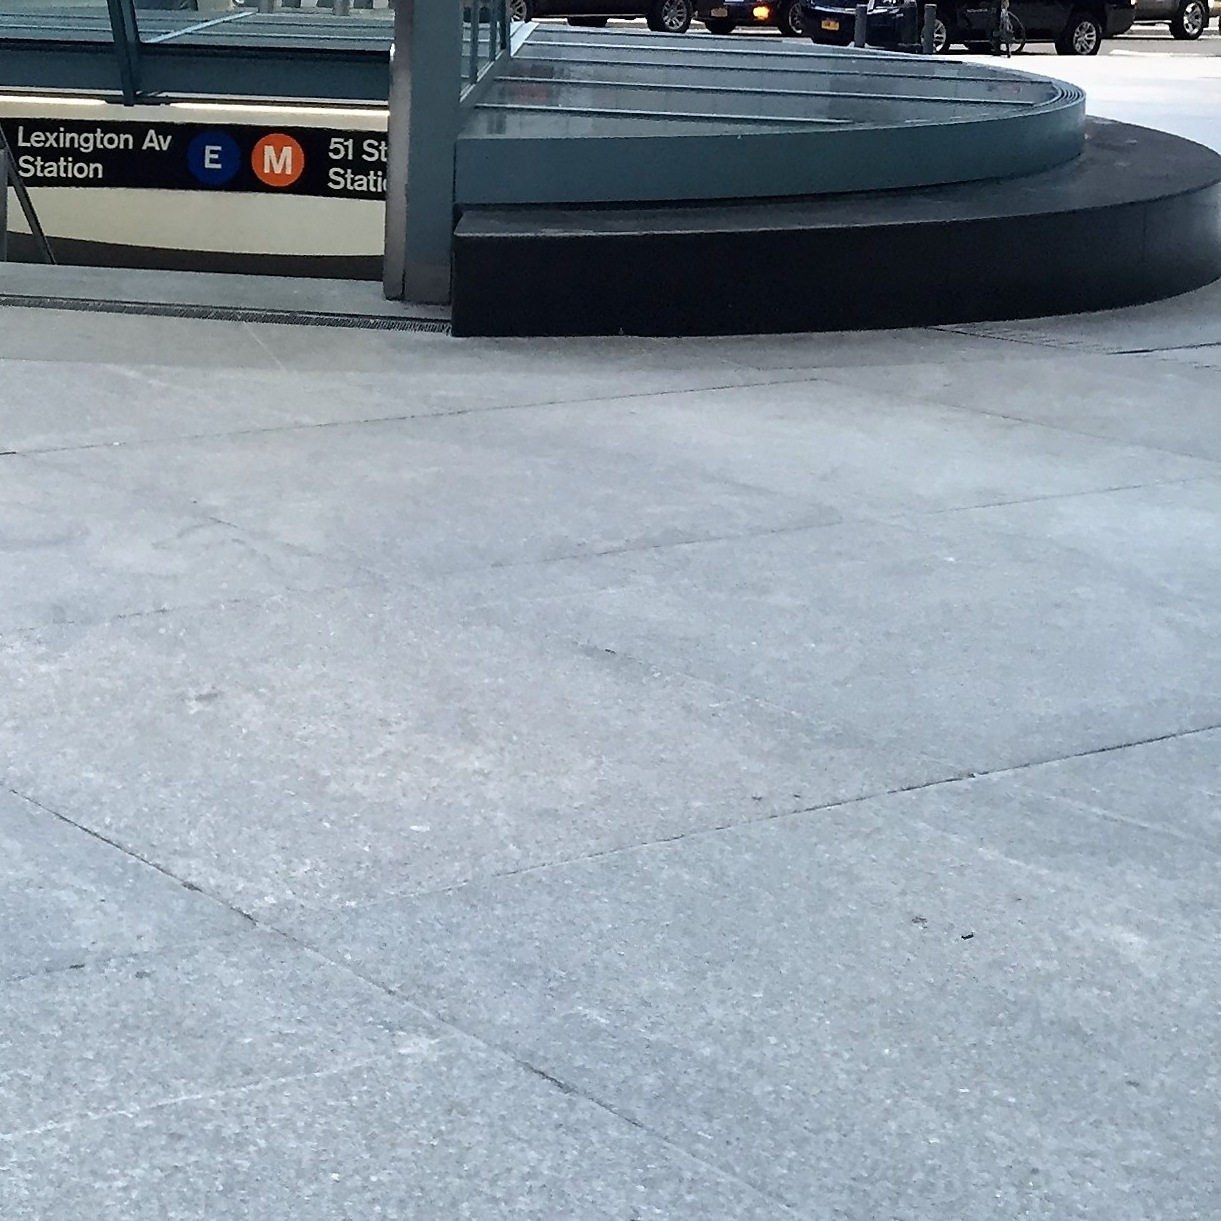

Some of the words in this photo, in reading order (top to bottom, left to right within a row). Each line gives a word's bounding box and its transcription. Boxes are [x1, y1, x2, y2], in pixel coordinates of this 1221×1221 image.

[17, 125, 134, 153] Lexington
[141, 129, 172, 151] Av
[328, 137, 354, 160] 51
[17, 155, 103, 179] Station
[204, 145, 222, 169] E
[263, 145, 293, 174] M
